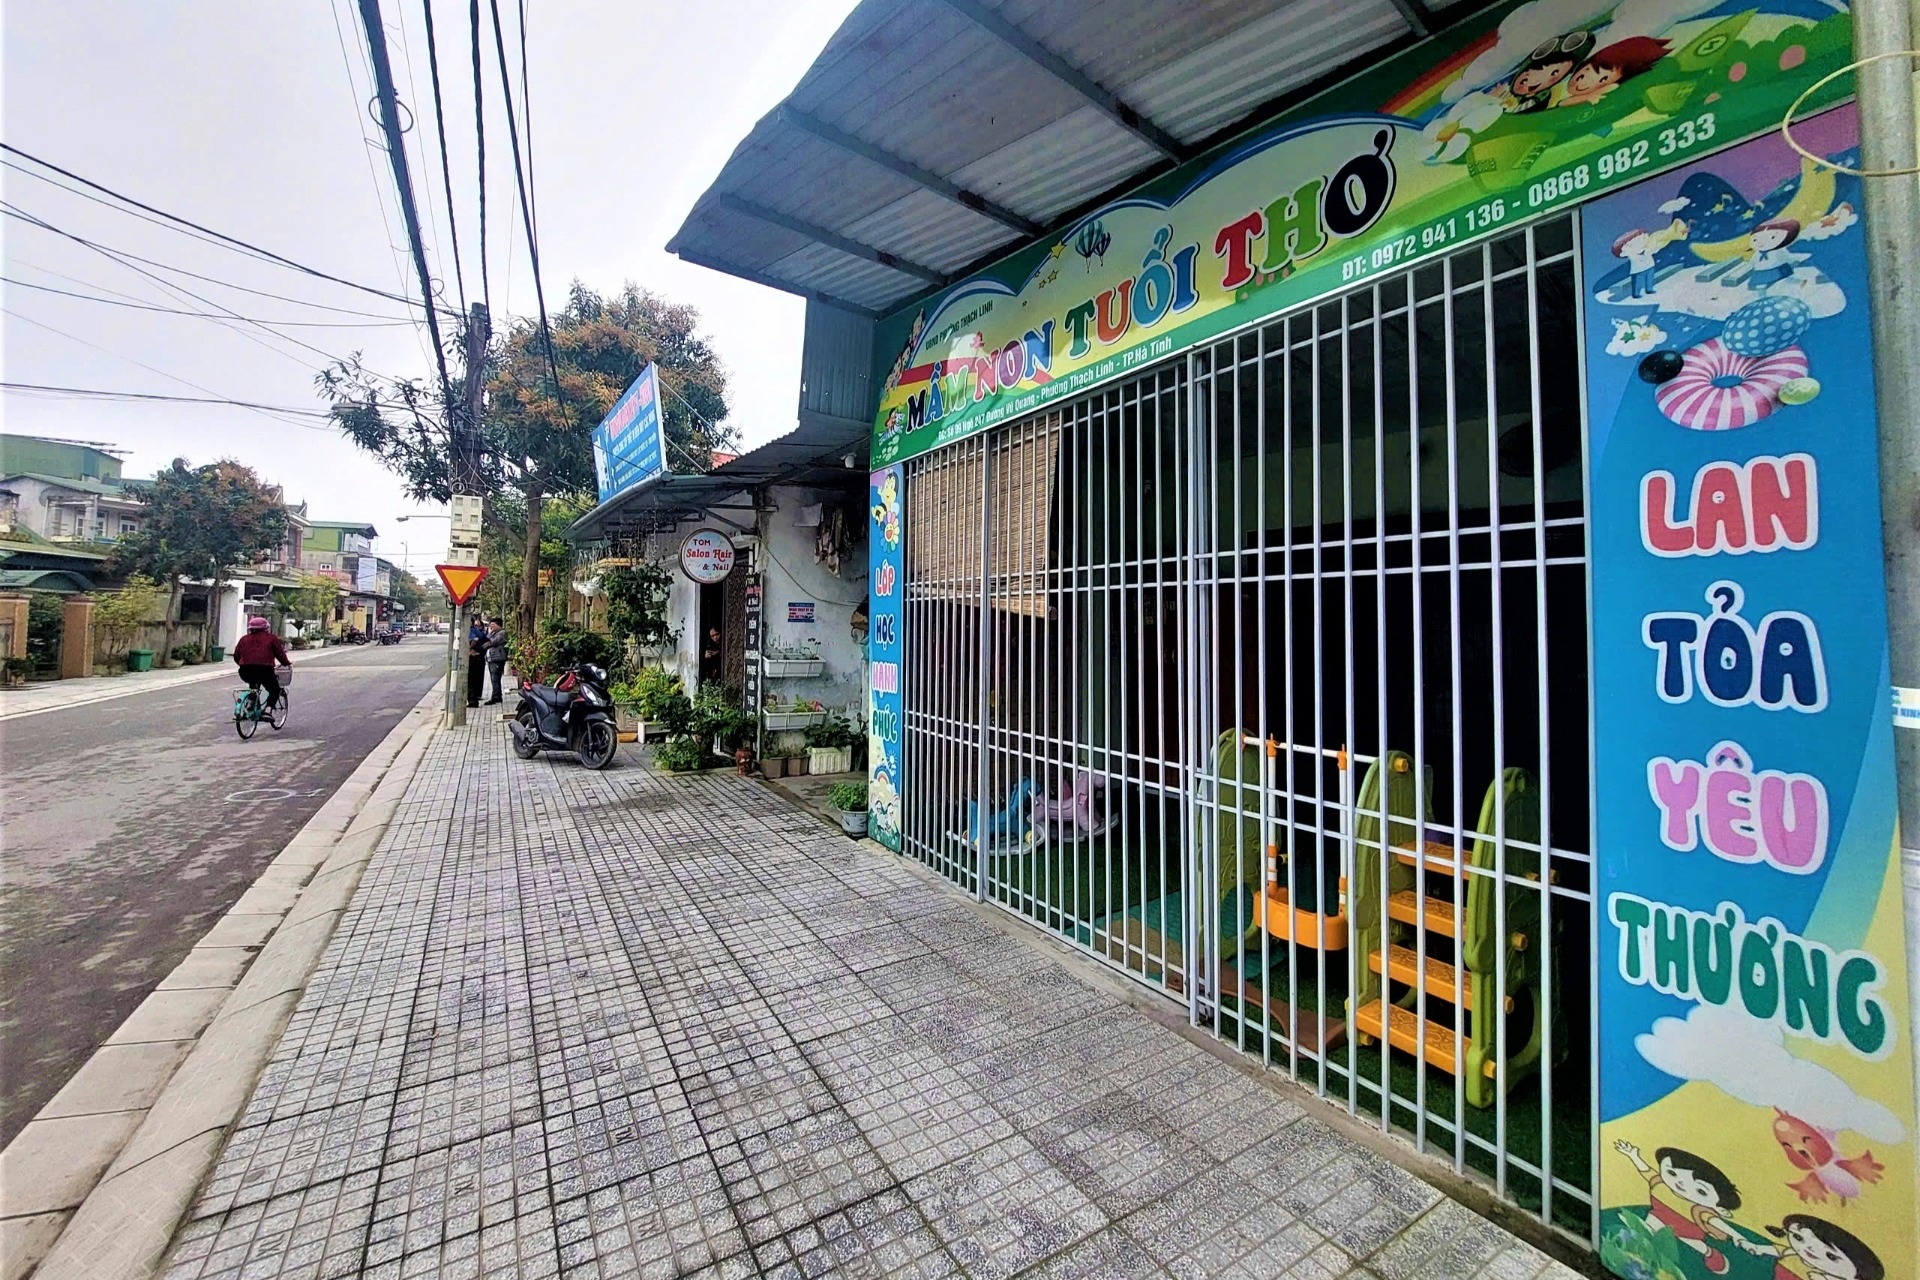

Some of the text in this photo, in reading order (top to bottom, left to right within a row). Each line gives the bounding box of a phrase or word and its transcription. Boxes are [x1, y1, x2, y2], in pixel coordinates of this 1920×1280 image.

[1342, 257, 1367, 281] ĐT:
[1371, 235, 1417, 268] 0972
[1422, 218, 1456, 249] 941
[1465, 199, 1505, 231] 136
[1528, 167, 1591, 208] 0868
[1597, 140, 1650, 179] 982
[1658, 112, 1716, 156] 333
[973, 317, 1056, 401] NON
[1064, 224, 1200, 361] TUỔI
[1214, 124, 1397, 291] THƠ
[960, 309, 978, 328] THẠCH
[979, 299, 993, 317] LINH
[1014, 394, 1035, 411] Quang
[1069, 369, 1094, 389] Thạch
[1095, 360, 1114, 379] Linh
[1641, 453, 1818, 557] LAN
[686, 549, 733, 562] Salon Hair
[702, 563, 729, 571] & Nail
[875, 559, 896, 597] LỚP
[875, 614, 895, 650] HỌC
[1643, 580, 1828, 713] TỎA
[872, 661, 898, 698] HẠNH
[872, 704, 898, 744] PHÚC
[1647, 740, 1829, 875] YÊU
[1608, 891, 1897, 1060] THƯƠNG
